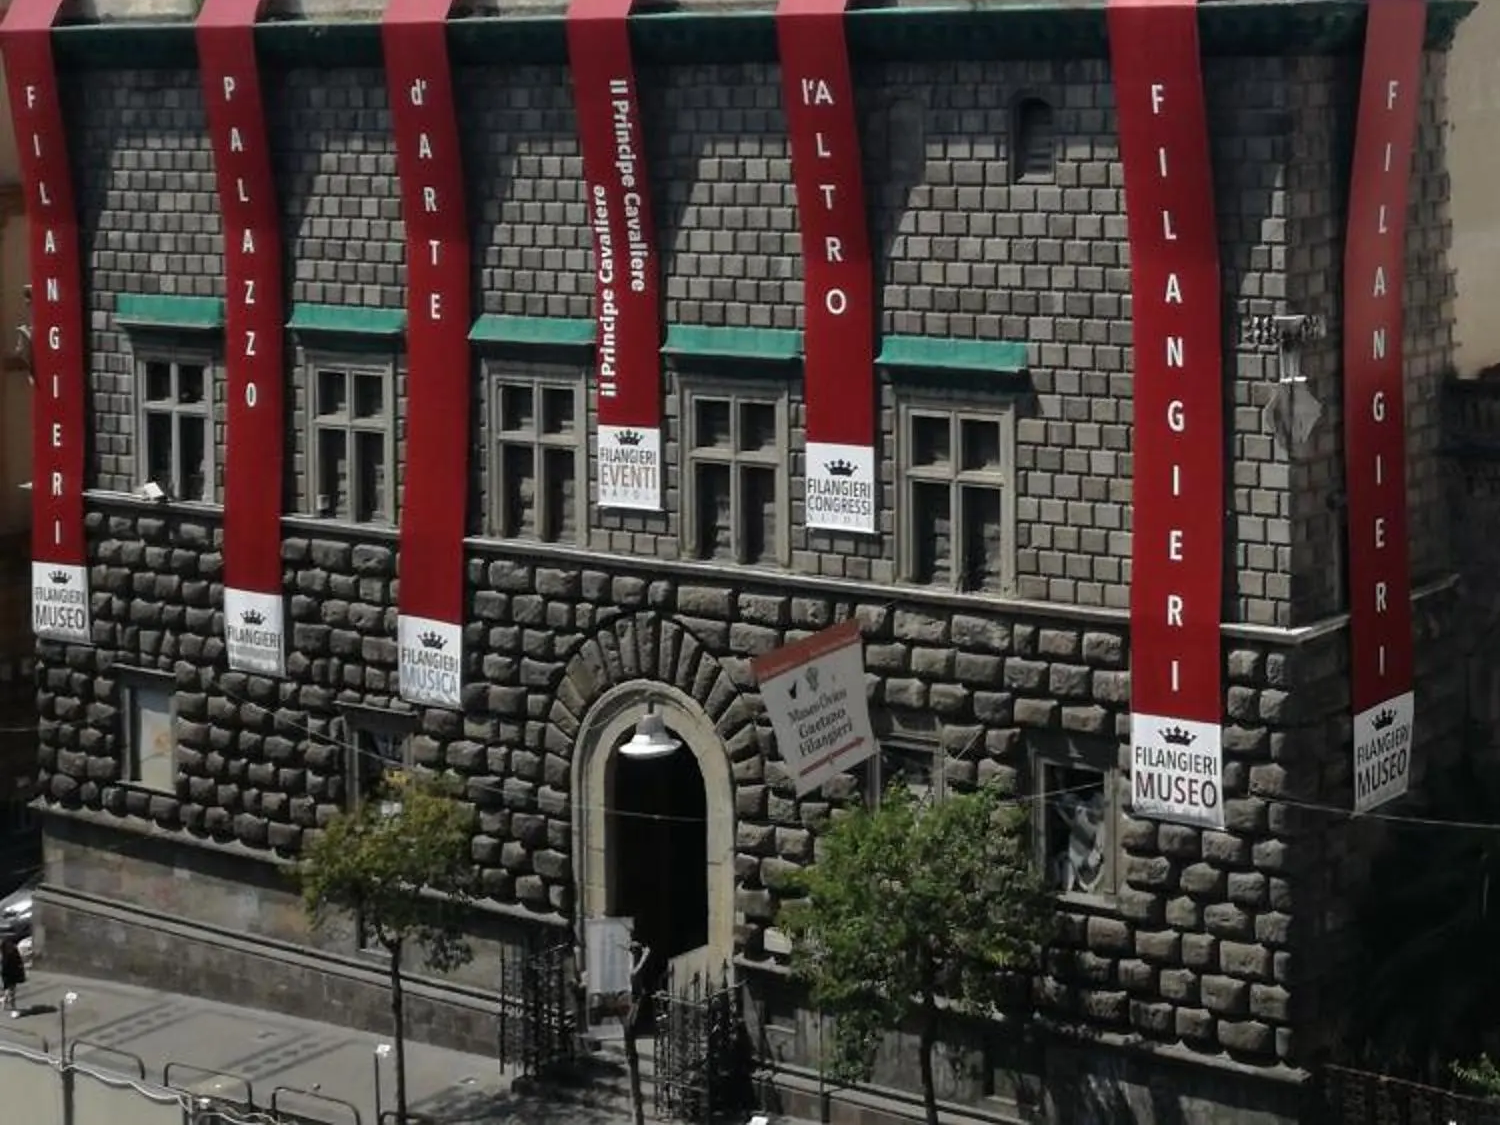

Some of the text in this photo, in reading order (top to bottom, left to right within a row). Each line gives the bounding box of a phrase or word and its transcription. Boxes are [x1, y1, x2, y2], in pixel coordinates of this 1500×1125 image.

[611, 100, 637, 188] Principe
[624, 192, 649, 292] Cavaliere
[223, 76, 257, 408] PALAZZO
[593, 185, 614, 283] Cavaliere
[26, 85, 63, 544] FILANGIERI
[600, 289, 619, 376] Principe
[1151, 84, 1185, 692] FILANGIERI
[1373, 80, 1399, 674] FILANGIERI
[599, 446, 657, 465] FILANGIERI
[601, 463, 657, 490] EVENTI
[807, 478, 872, 499] FILANGIERI
[807, 495, 872, 516] CONGRESSI
[35, 604, 85, 629] MUSEO
[227, 625, 281, 649] FILANGIERI
[402, 648, 459, 673] FILANGIERI
[402, 664, 457, 694] MUSICA
[1135, 746, 1217, 776] FILANGIERI
[1358, 749, 1407, 800] MUSEO
[1135, 770, 1217, 809] MUSEO
